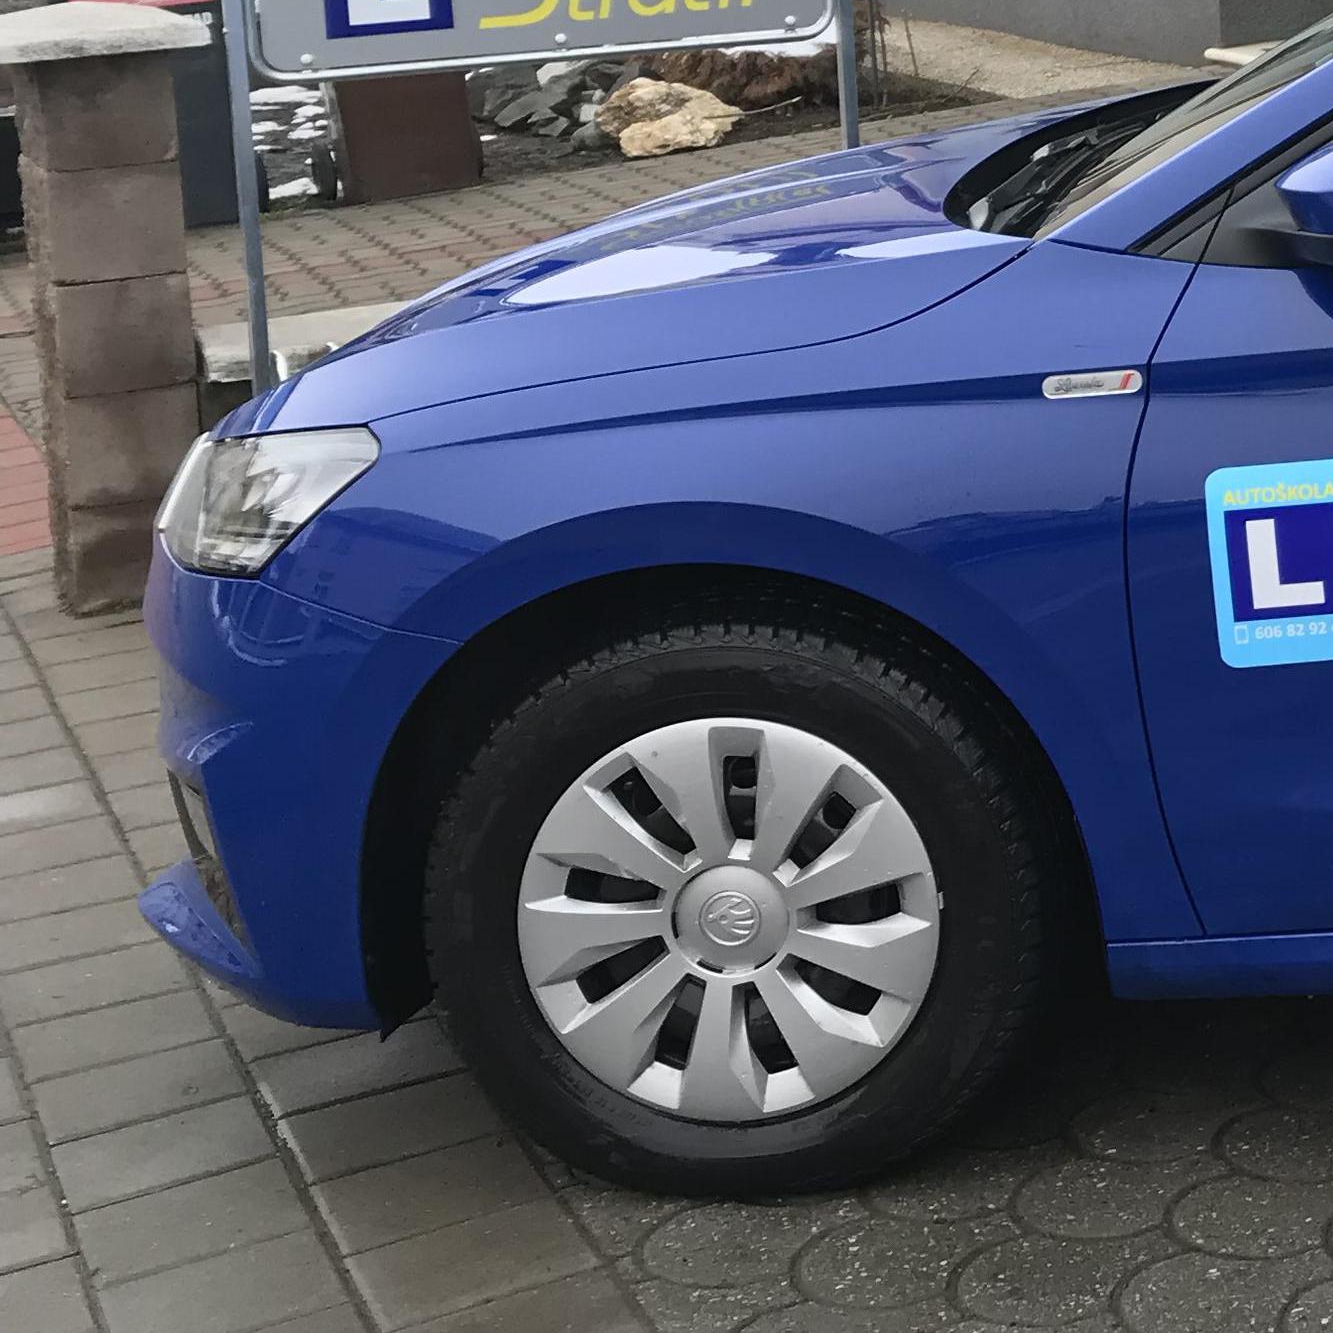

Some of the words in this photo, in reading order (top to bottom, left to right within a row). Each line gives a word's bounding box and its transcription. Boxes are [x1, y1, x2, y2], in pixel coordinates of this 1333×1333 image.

[1245, 518, 1326, 610] L
[1255, 624, 1283, 640] 606
[1287, 623, 1305, 637] 82
[1309, 621, 1328, 635] 92
